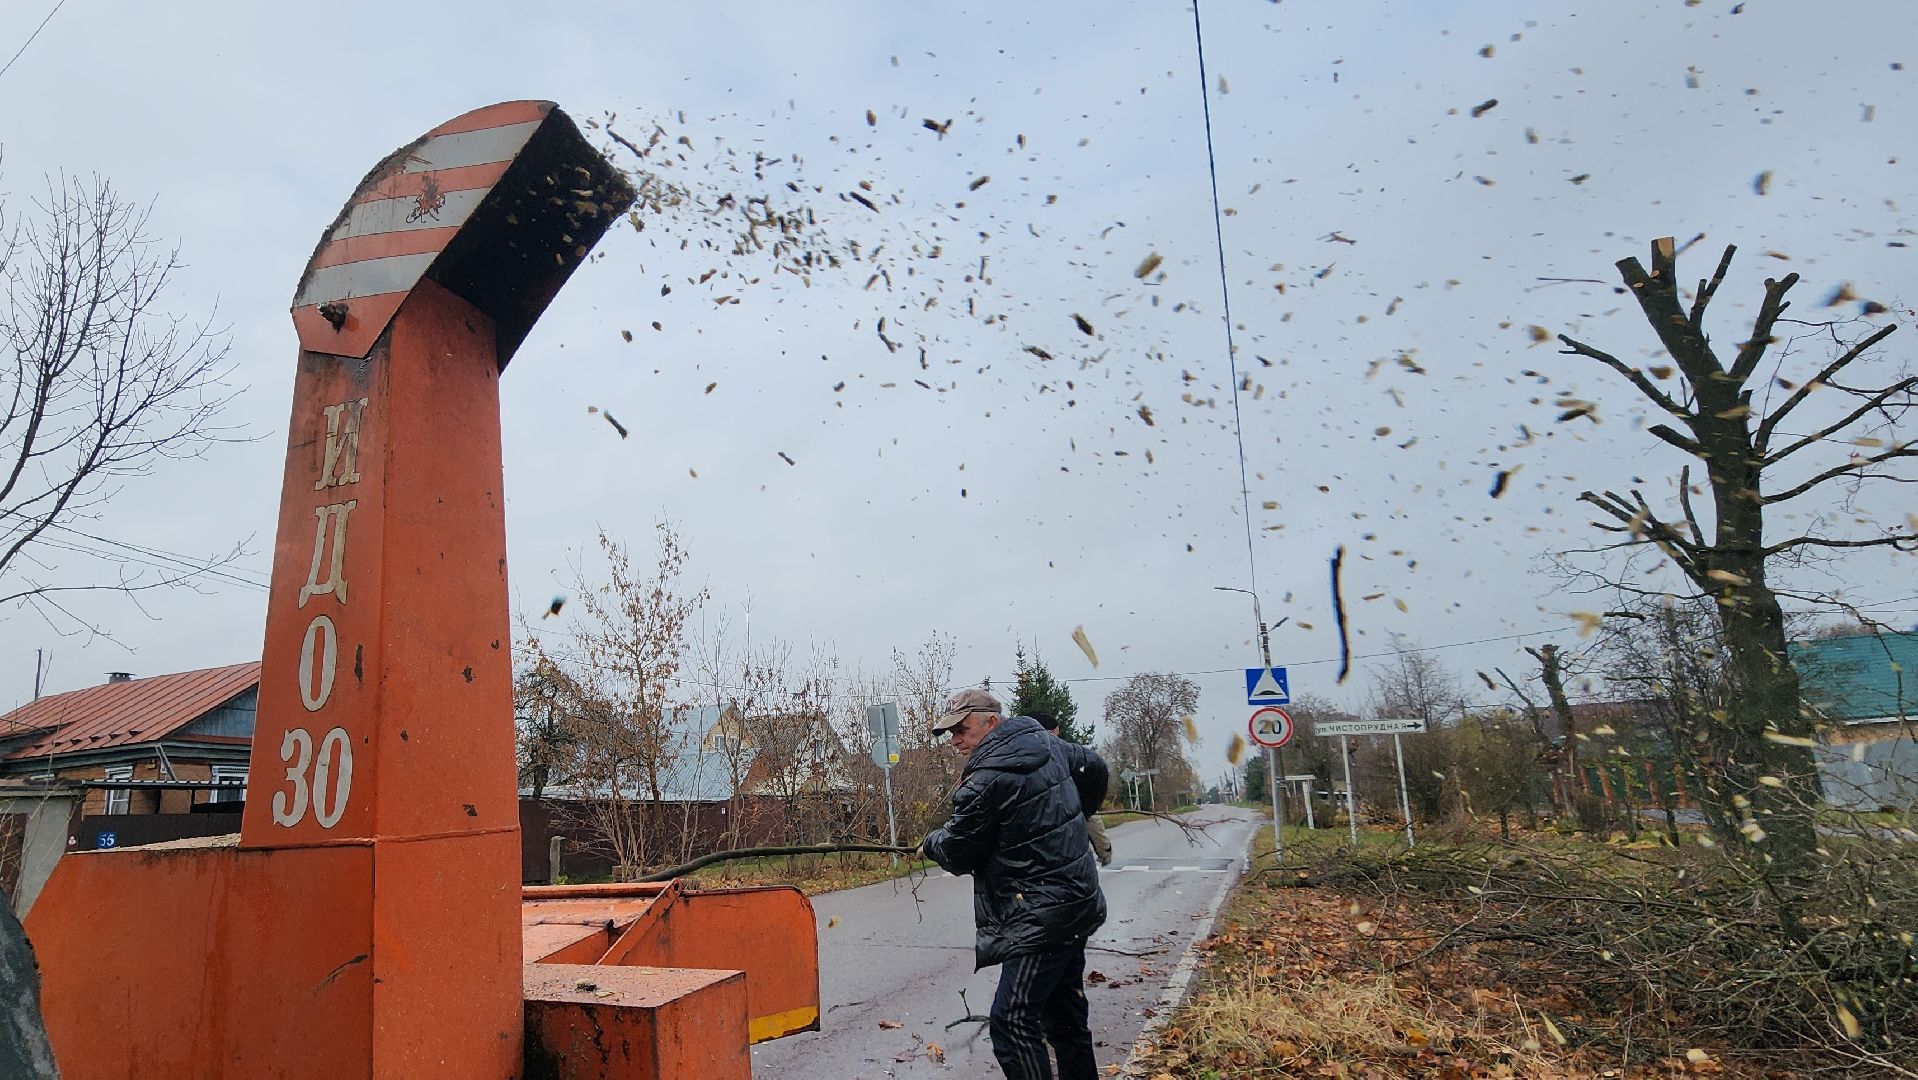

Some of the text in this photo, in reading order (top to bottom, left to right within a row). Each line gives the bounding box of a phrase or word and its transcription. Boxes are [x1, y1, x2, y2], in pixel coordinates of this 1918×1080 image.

[1258, 720, 1282, 735] 20
[1328, 723, 1407, 732] ЧИСТОПРУДНАЯ
[272, 727, 353, 829] 30
